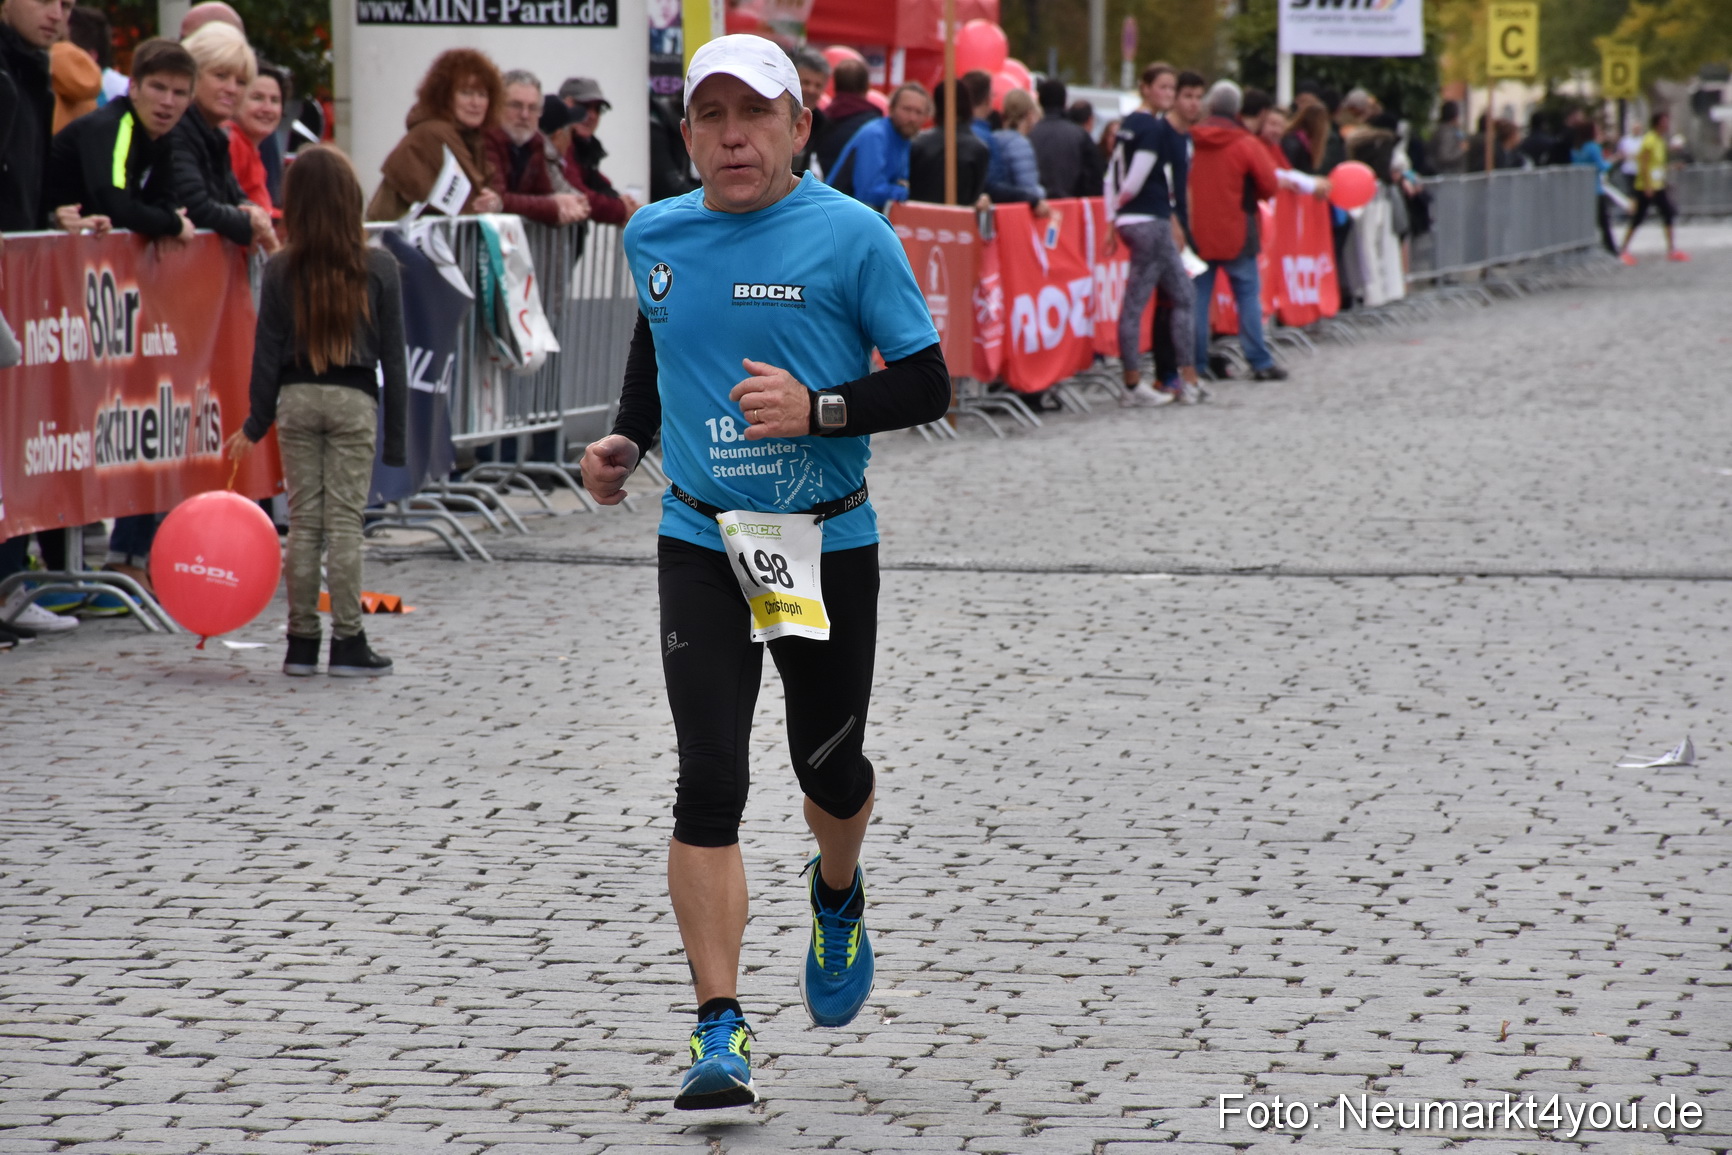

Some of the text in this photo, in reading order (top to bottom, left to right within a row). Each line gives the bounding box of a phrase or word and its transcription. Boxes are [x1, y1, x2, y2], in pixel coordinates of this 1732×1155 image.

[1501, 25, 1524, 58] C
[1612, 62, 1630, 86] D
[650, 264, 672, 277] BMW
[733, 284, 803, 301] BOCK
[648, 306, 668, 316] ARTL
[705, 416, 745, 443] 18.
[709, 443, 797, 459] Neumarkter
[712, 459, 784, 478] Stadtlauf
[784, 474, 808, 505] September
[739, 523, 782, 536] BOCK
[738, 549, 794, 589] 198
[764, 599, 803, 616] Christoph
